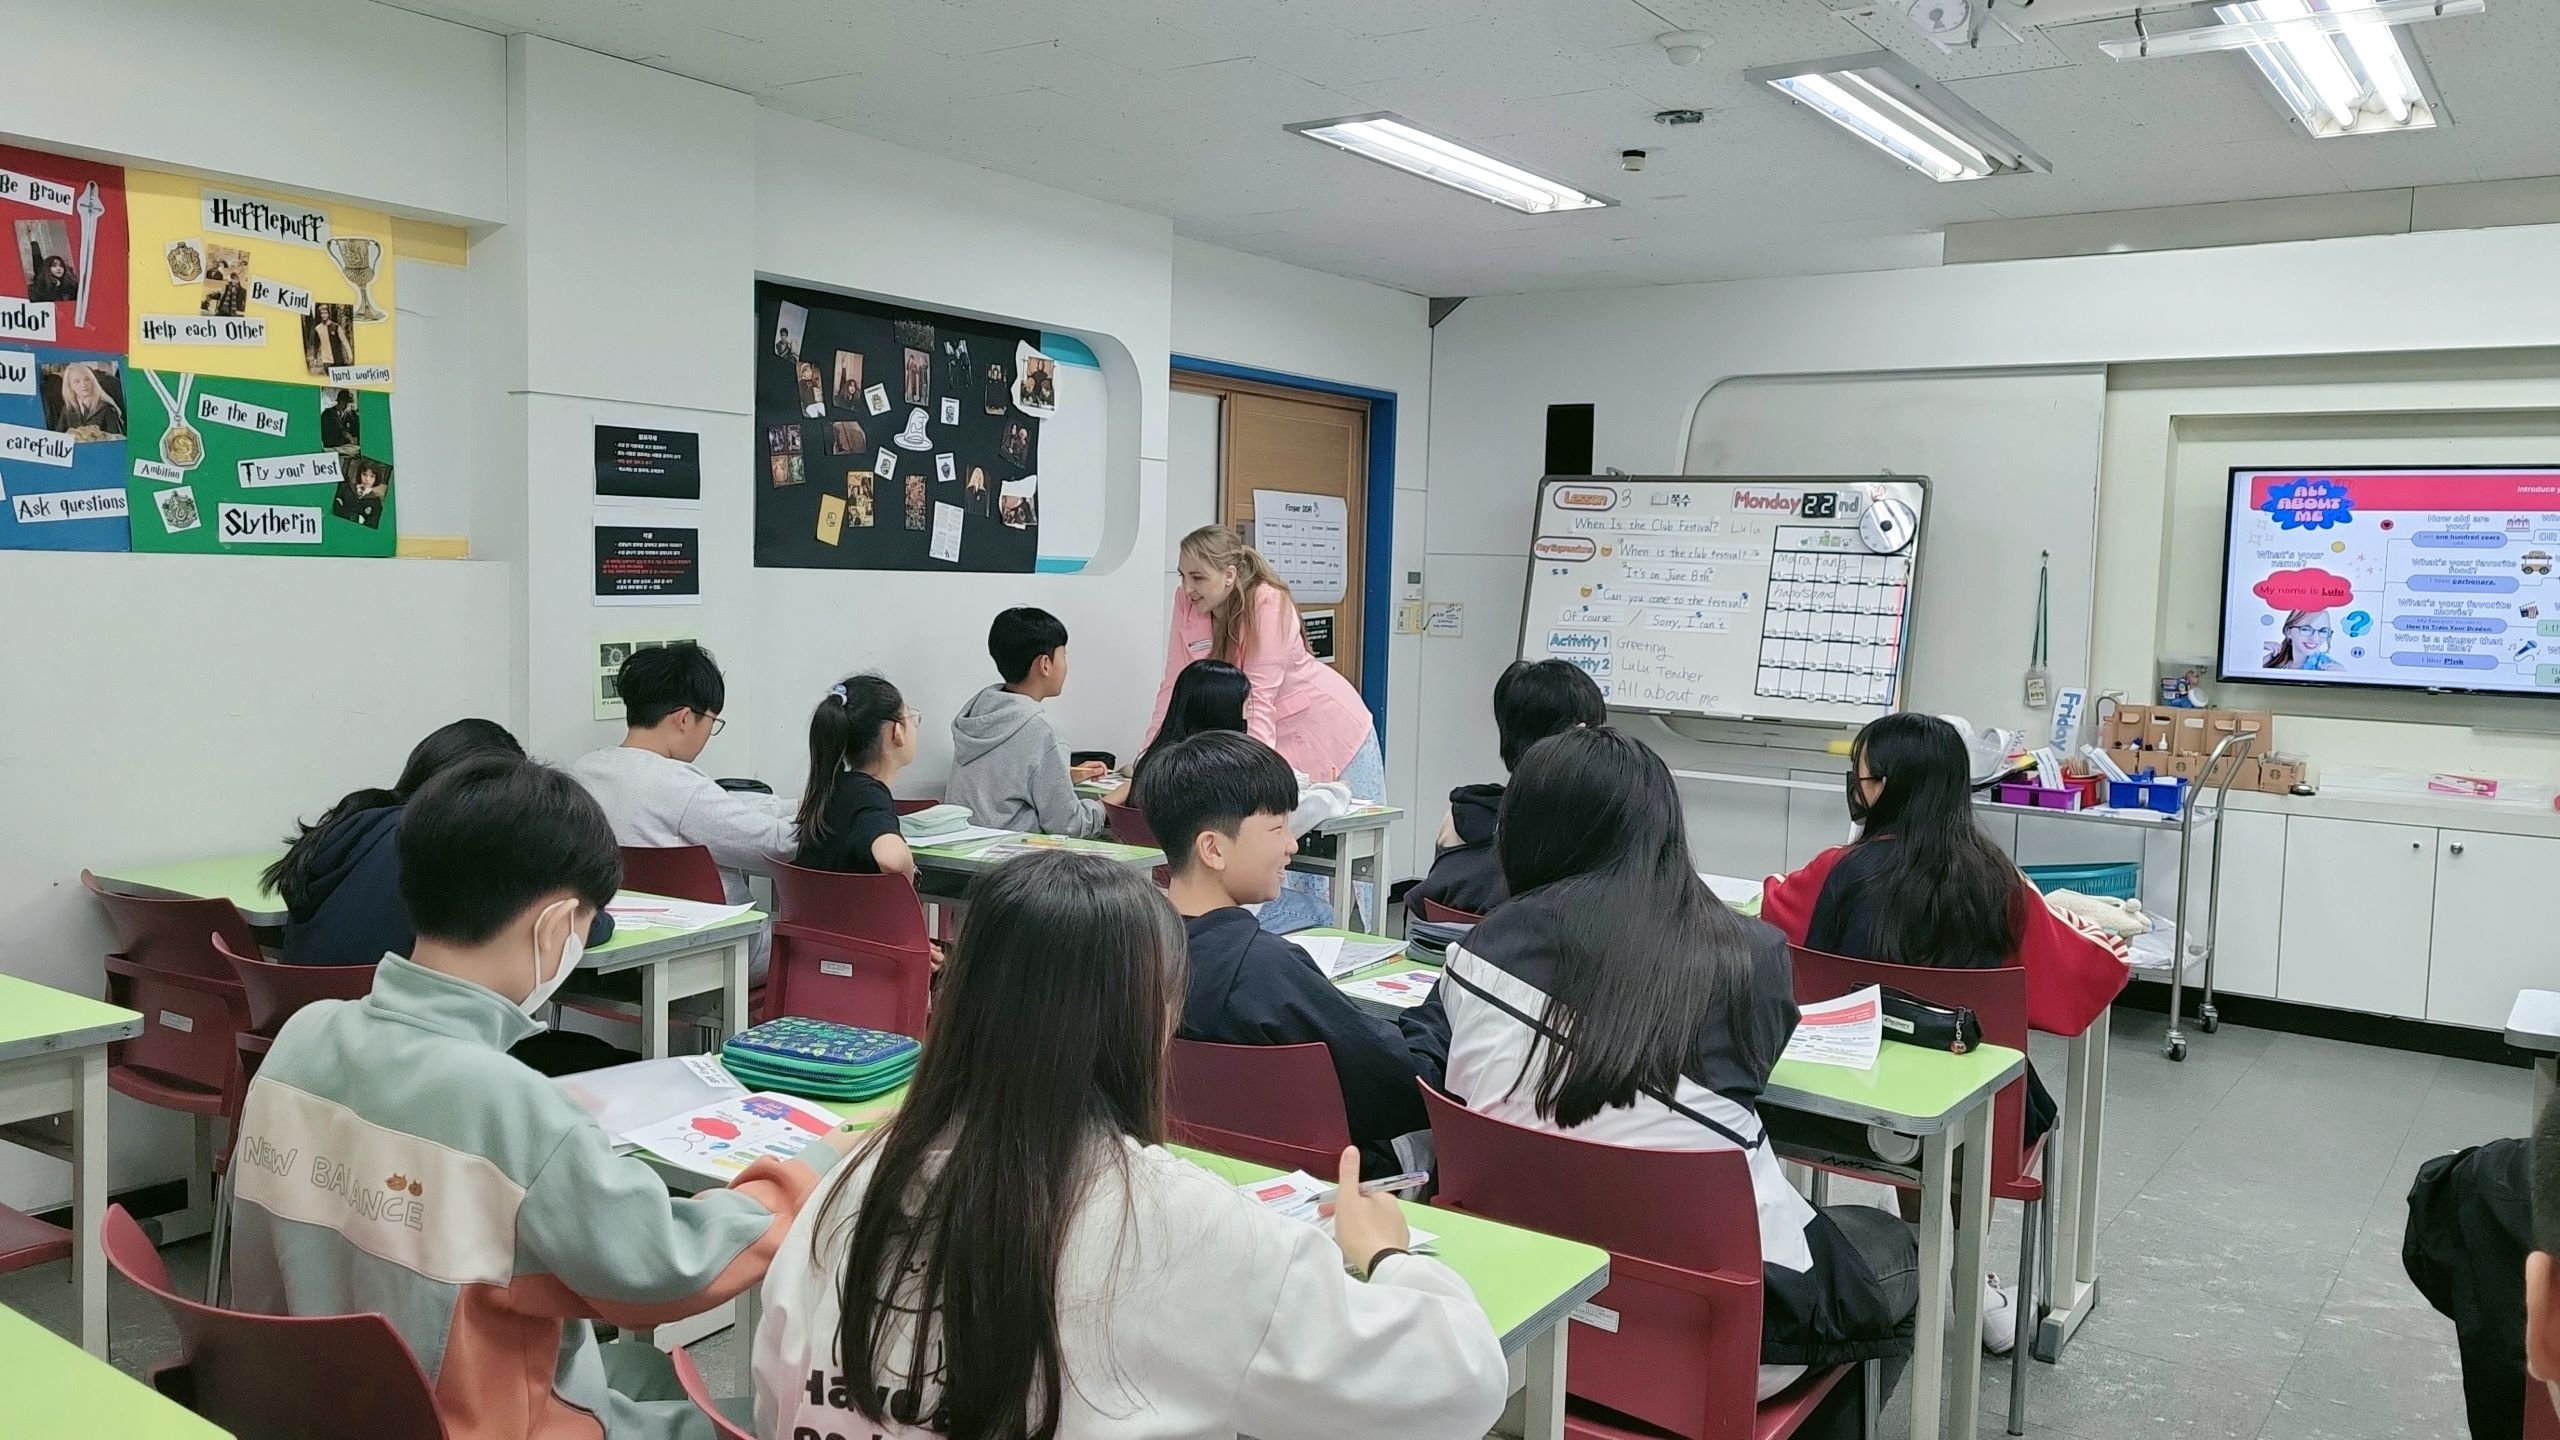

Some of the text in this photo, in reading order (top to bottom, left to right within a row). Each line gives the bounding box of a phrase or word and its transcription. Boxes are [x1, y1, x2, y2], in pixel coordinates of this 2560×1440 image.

[0, 174, 71, 206] Be Brave
[210, 198, 324, 243] Hufflepuff
[252, 281, 309, 309] Be Kind
[0, 303, 50, 332] ndor
[143, 320, 265, 342] Help each Other
[331, 368, 390, 383] hard working
[200, 400, 285, 433] Be the Best
[6, 436, 73, 459] carefully
[140, 463, 181, 480] Ambition
[239, 459, 339, 486] Try your best
[1563, 490, 1608, 506] Lesson
[2517, 486, 2556, 494] Introduce
[18, 493, 126, 520] Ask questions
[1734, 490, 1802, 515] Monday
[2277, 497, 2341, 510] ABOUT
[224, 507, 316, 537] Slytherin
[2294, 511, 2324, 522] ME
[2428, 514, 2490, 524] How old are
[1575, 517, 1720, 533] When Is the Club Festival?
[2449, 533, 2480, 541] hundred
[1619, 543, 1649, 557] When
[1656, 547, 1665, 557] is
[1671, 546, 1685, 558] the
[1688, 546, 1708, 559] club
[2256, 550, 2325, 561] What's your
[2271, 560, 2308, 568] name?
[2411, 558, 2518, 568] What's your favorite
[1650, 571, 1660, 579] on
[1665, 568, 1686, 582] June
[1603, 588, 1622, 601] Can
[1674, 594, 1684, 605] to
[1687, 594, 1705, 606] the
[2260, 586, 2345, 597] My name is Lulu
[2397, 598, 2512, 610] What's your favorite
[1562, 610, 1577, 622] Of
[1550, 632, 1674, 662] Activity 1 Greeting
[2394, 634, 2420, 643] Who
[2421, 634, 2431, 643] is
[2442, 635, 2477, 645] singer
[2479, 637, 2504, 646] that
[2423, 644, 2445, 652] you
[1602, 658, 1610, 670] 2
[1656, 666, 1704, 684] Teacher
[1602, 680, 1720, 708] 3 All about me
[2050, 692, 2082, 752] Friday
[244, 1137, 298, 1177] NEW
